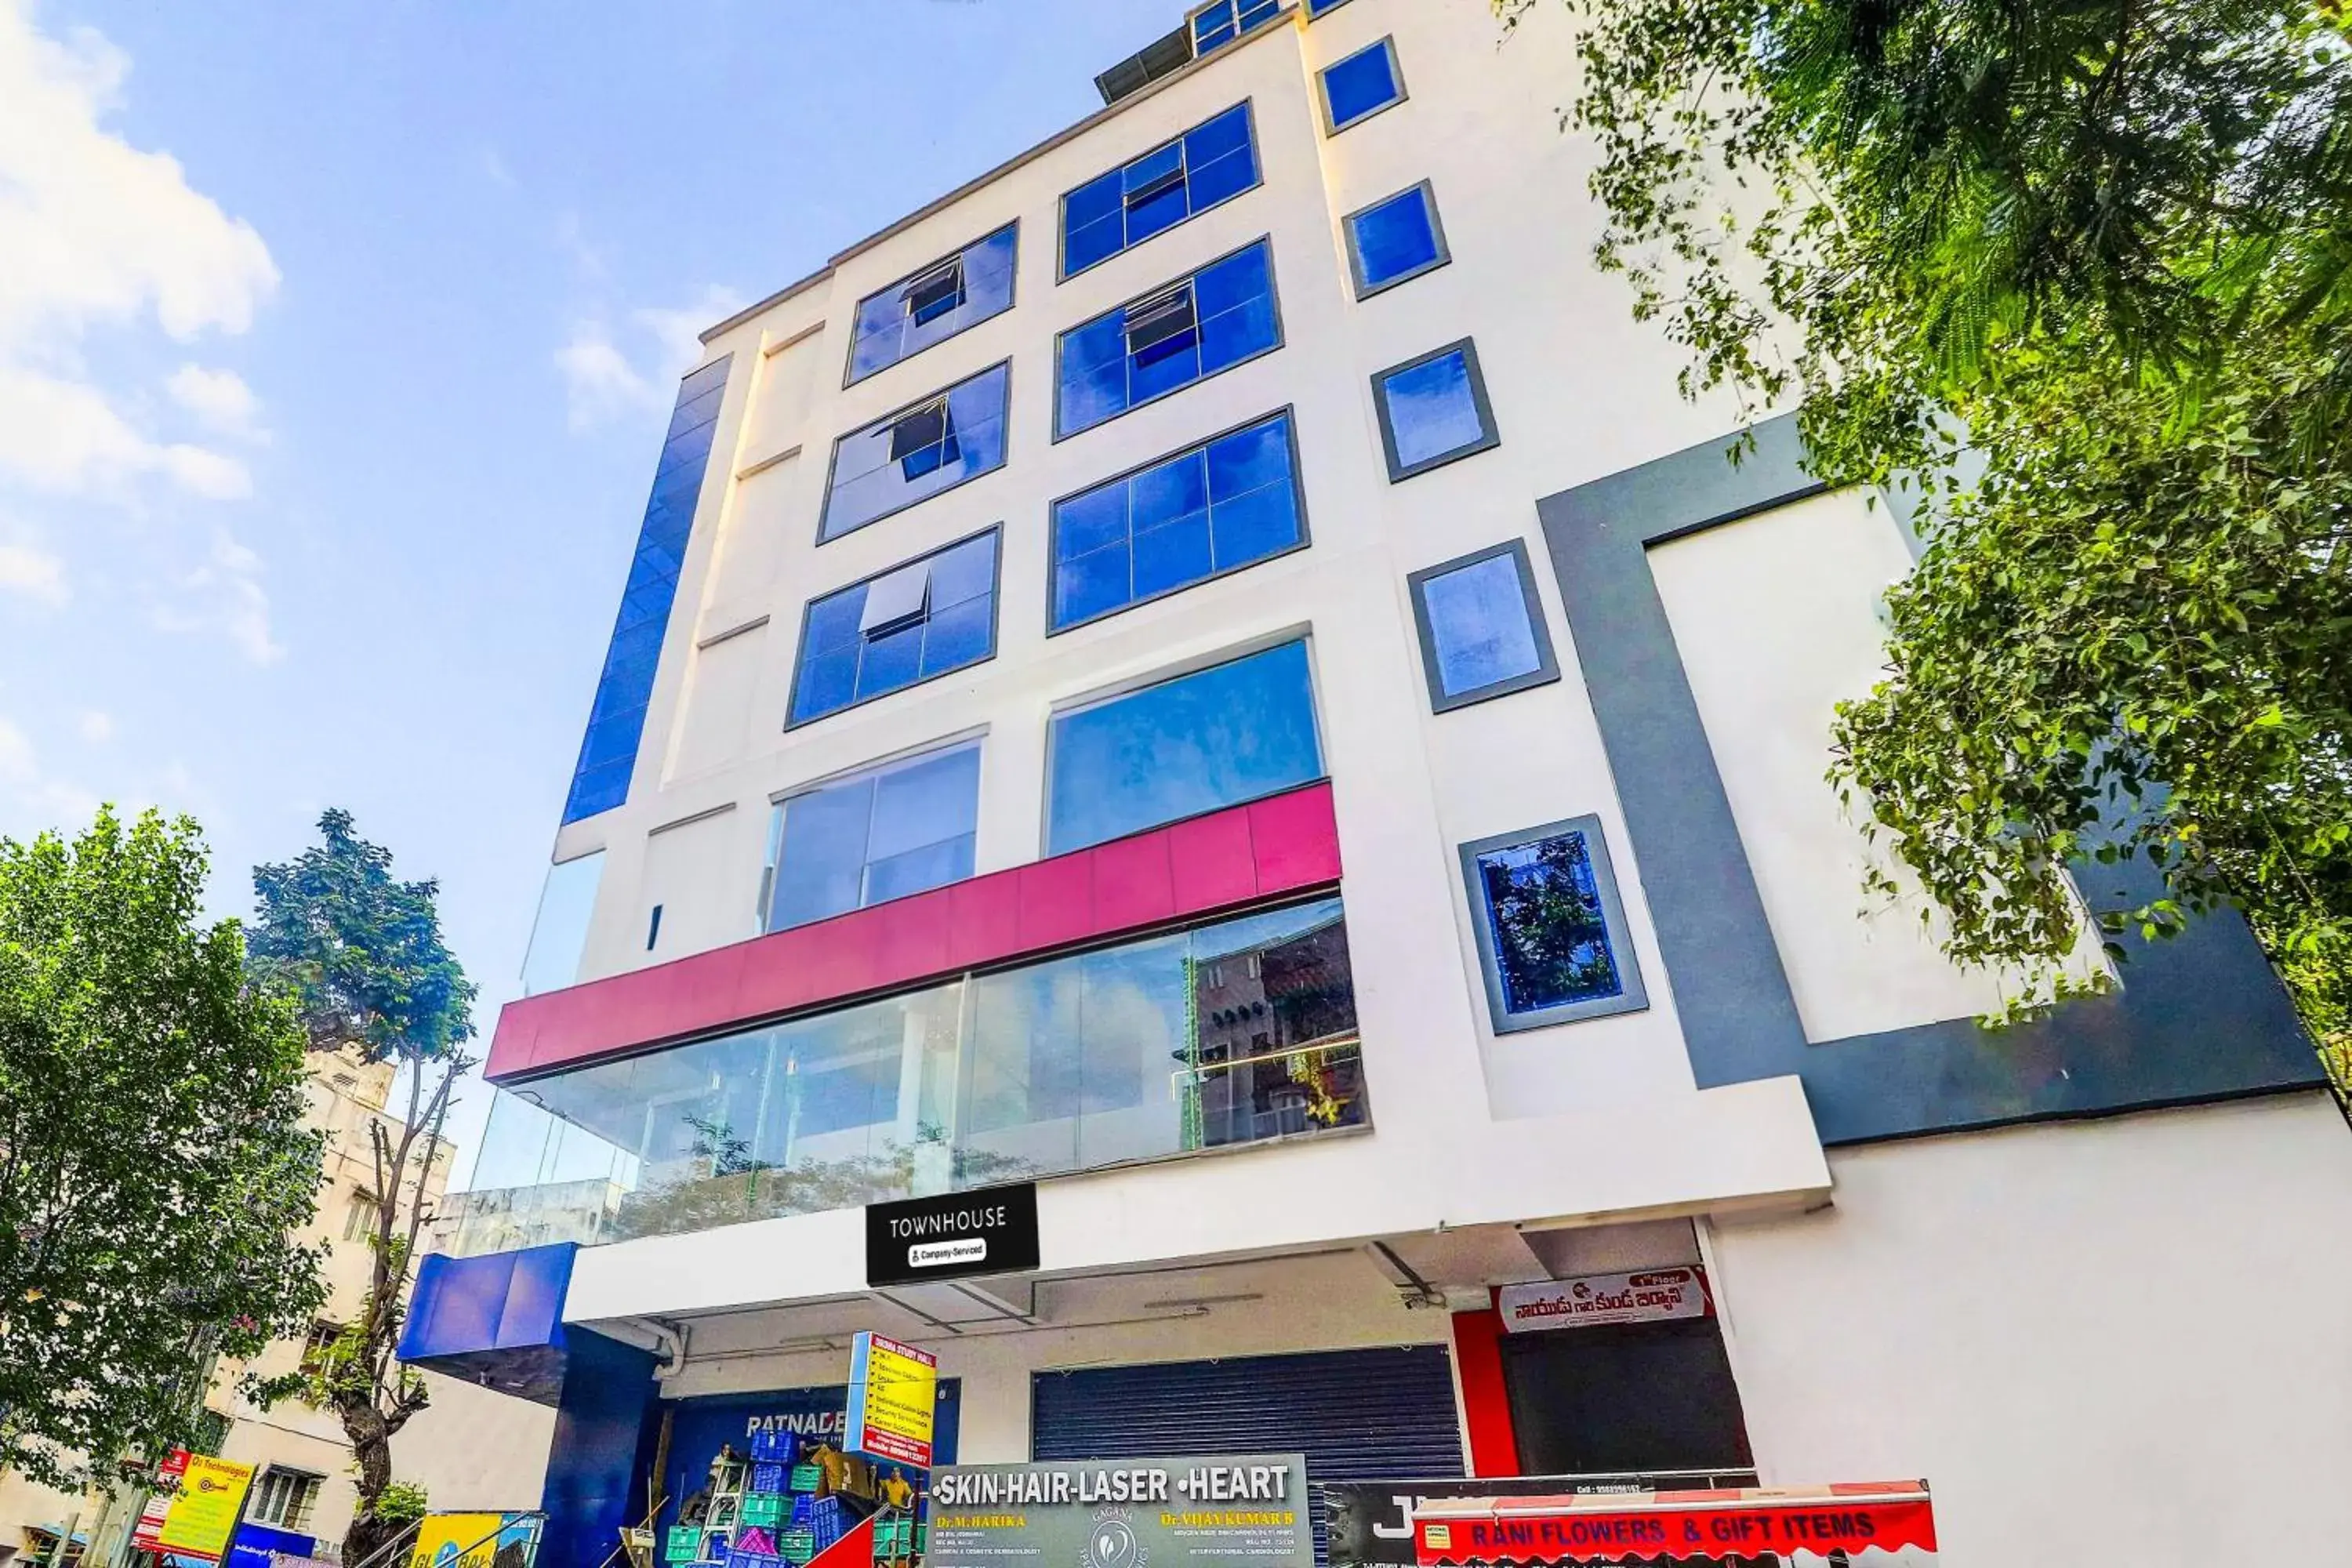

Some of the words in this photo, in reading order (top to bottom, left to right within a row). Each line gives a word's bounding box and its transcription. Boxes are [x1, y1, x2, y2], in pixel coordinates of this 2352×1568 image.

[890, 1206, 1007, 1238] TOWNHOUSE
[920, 1245, 983, 1260] Company-Serviced
[1652, 1275, 1681, 1285] Floor
[205, 1459, 250, 1478] Technologies
[1225, 1511, 1280, 1526] KUMAR
[1283, 1511, 1294, 1526] B
[1472, 1523, 1534, 1545] RANI
[1541, 1519, 1665, 1544] FLOWERS
[1683, 1517, 1701, 1542] &
[1711, 1515, 1773, 1542] GIFT
[1784, 1512, 1876, 1539] ITEMS
